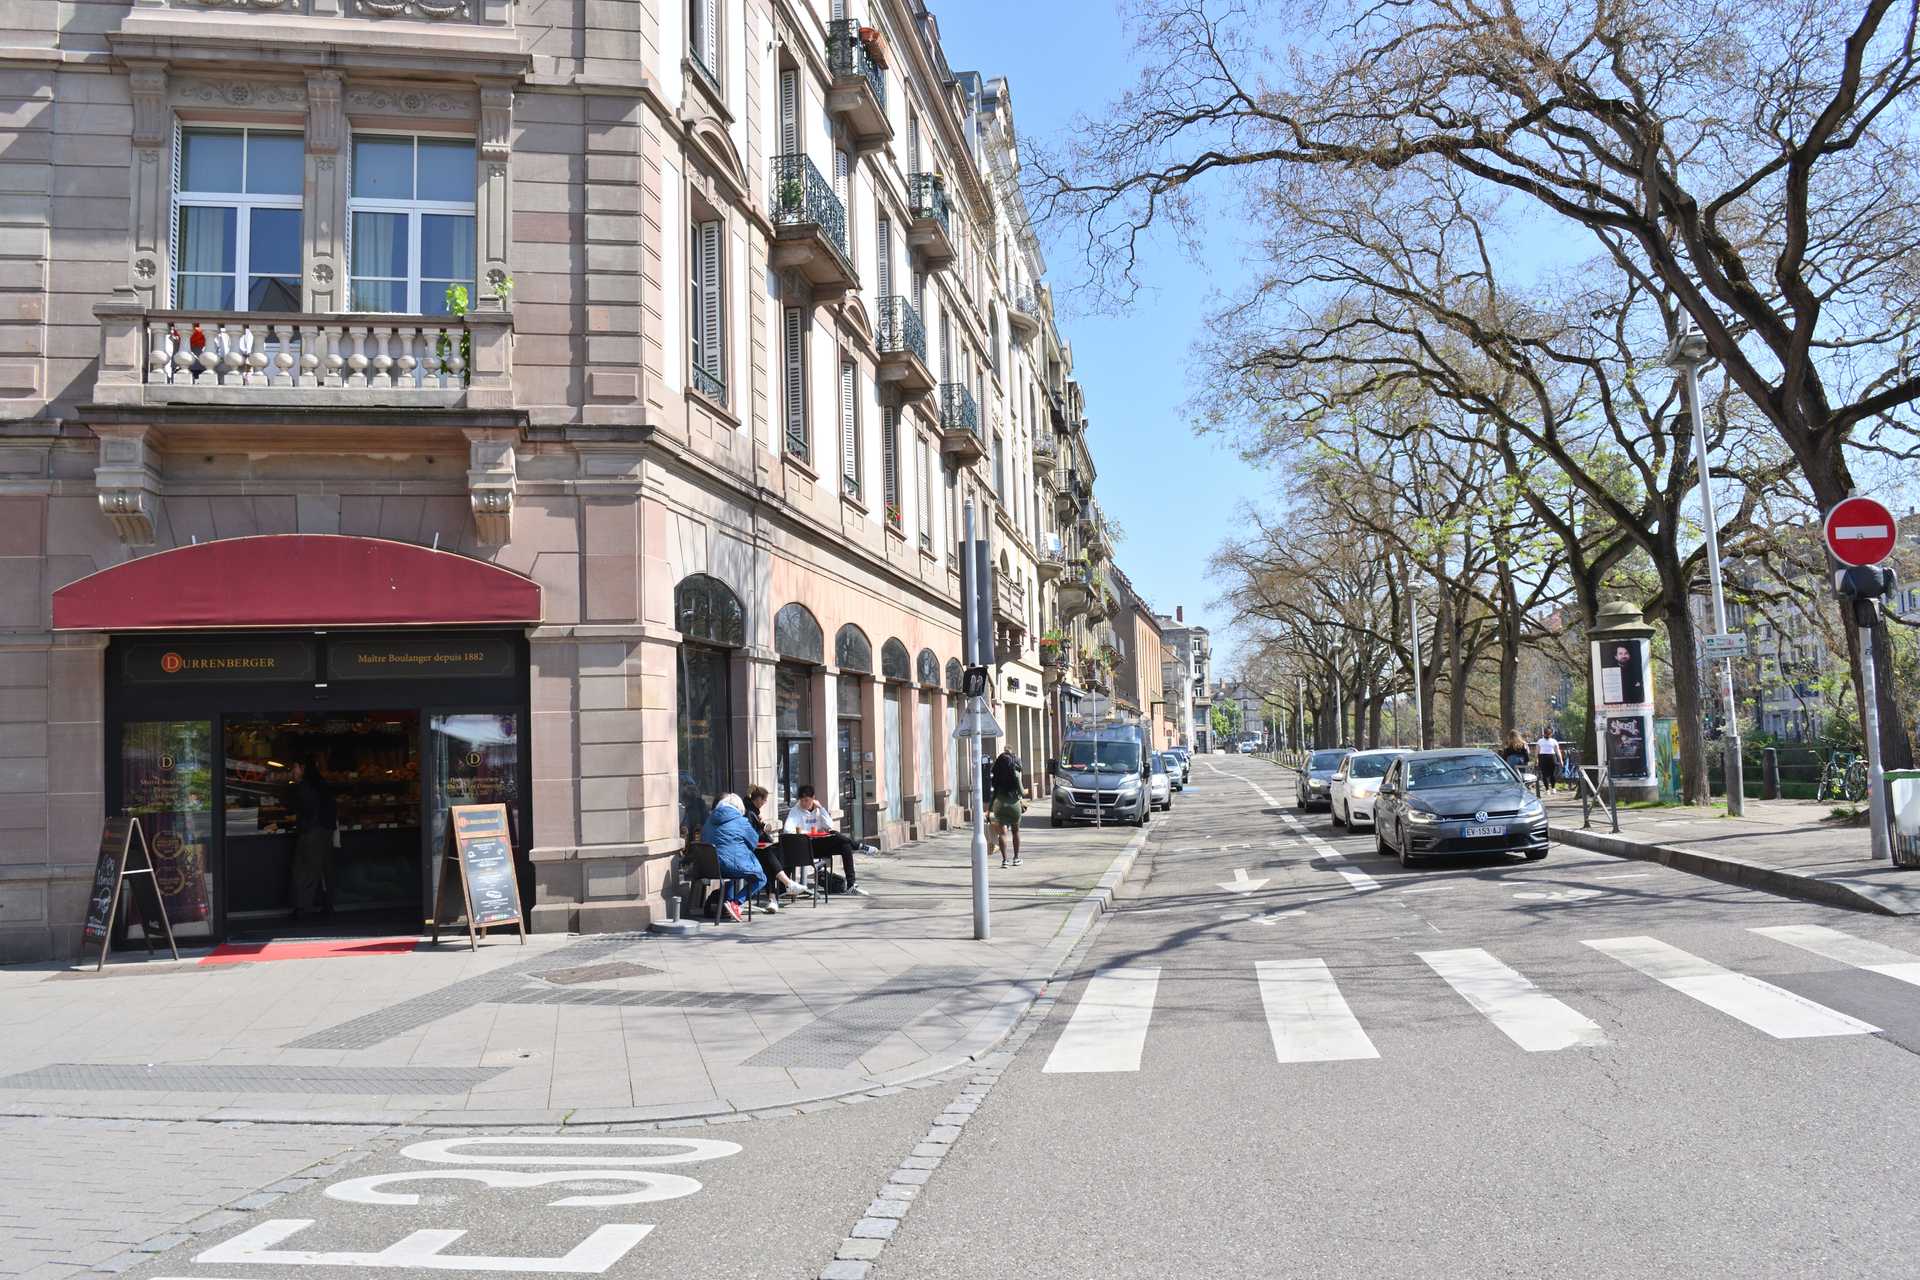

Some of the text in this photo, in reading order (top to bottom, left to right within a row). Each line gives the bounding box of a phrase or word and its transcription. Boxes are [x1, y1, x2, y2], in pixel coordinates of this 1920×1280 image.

[357, 652, 484, 664] Maître Boulanger depuis 1882
